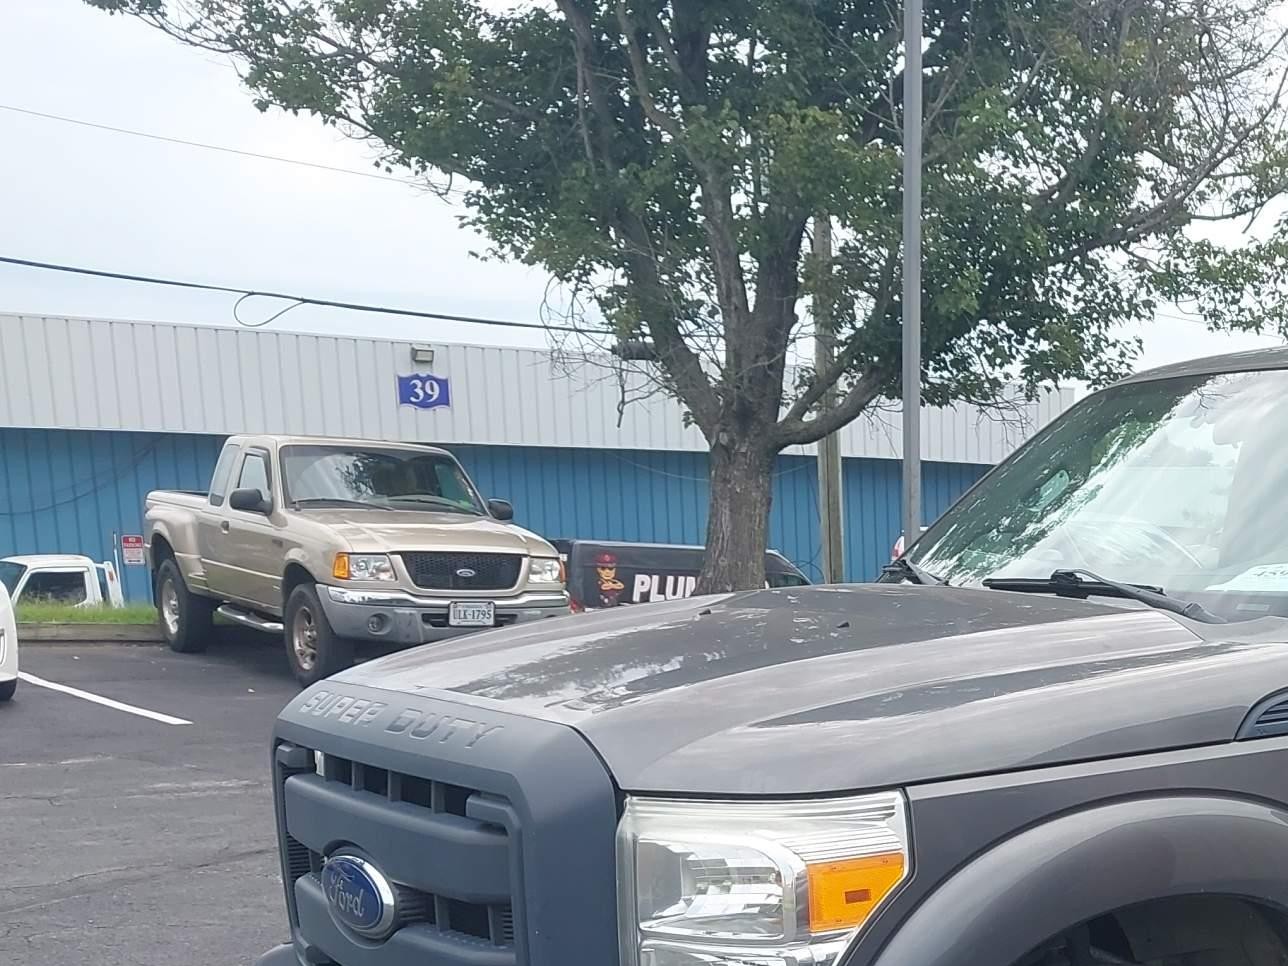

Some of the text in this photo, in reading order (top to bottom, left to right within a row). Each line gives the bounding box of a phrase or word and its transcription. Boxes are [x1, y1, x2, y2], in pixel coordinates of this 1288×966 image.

[409, 379, 440, 402] 39
[299, 690, 504, 749] SUPER DUTY
[328, 866, 366, 917] Ford
